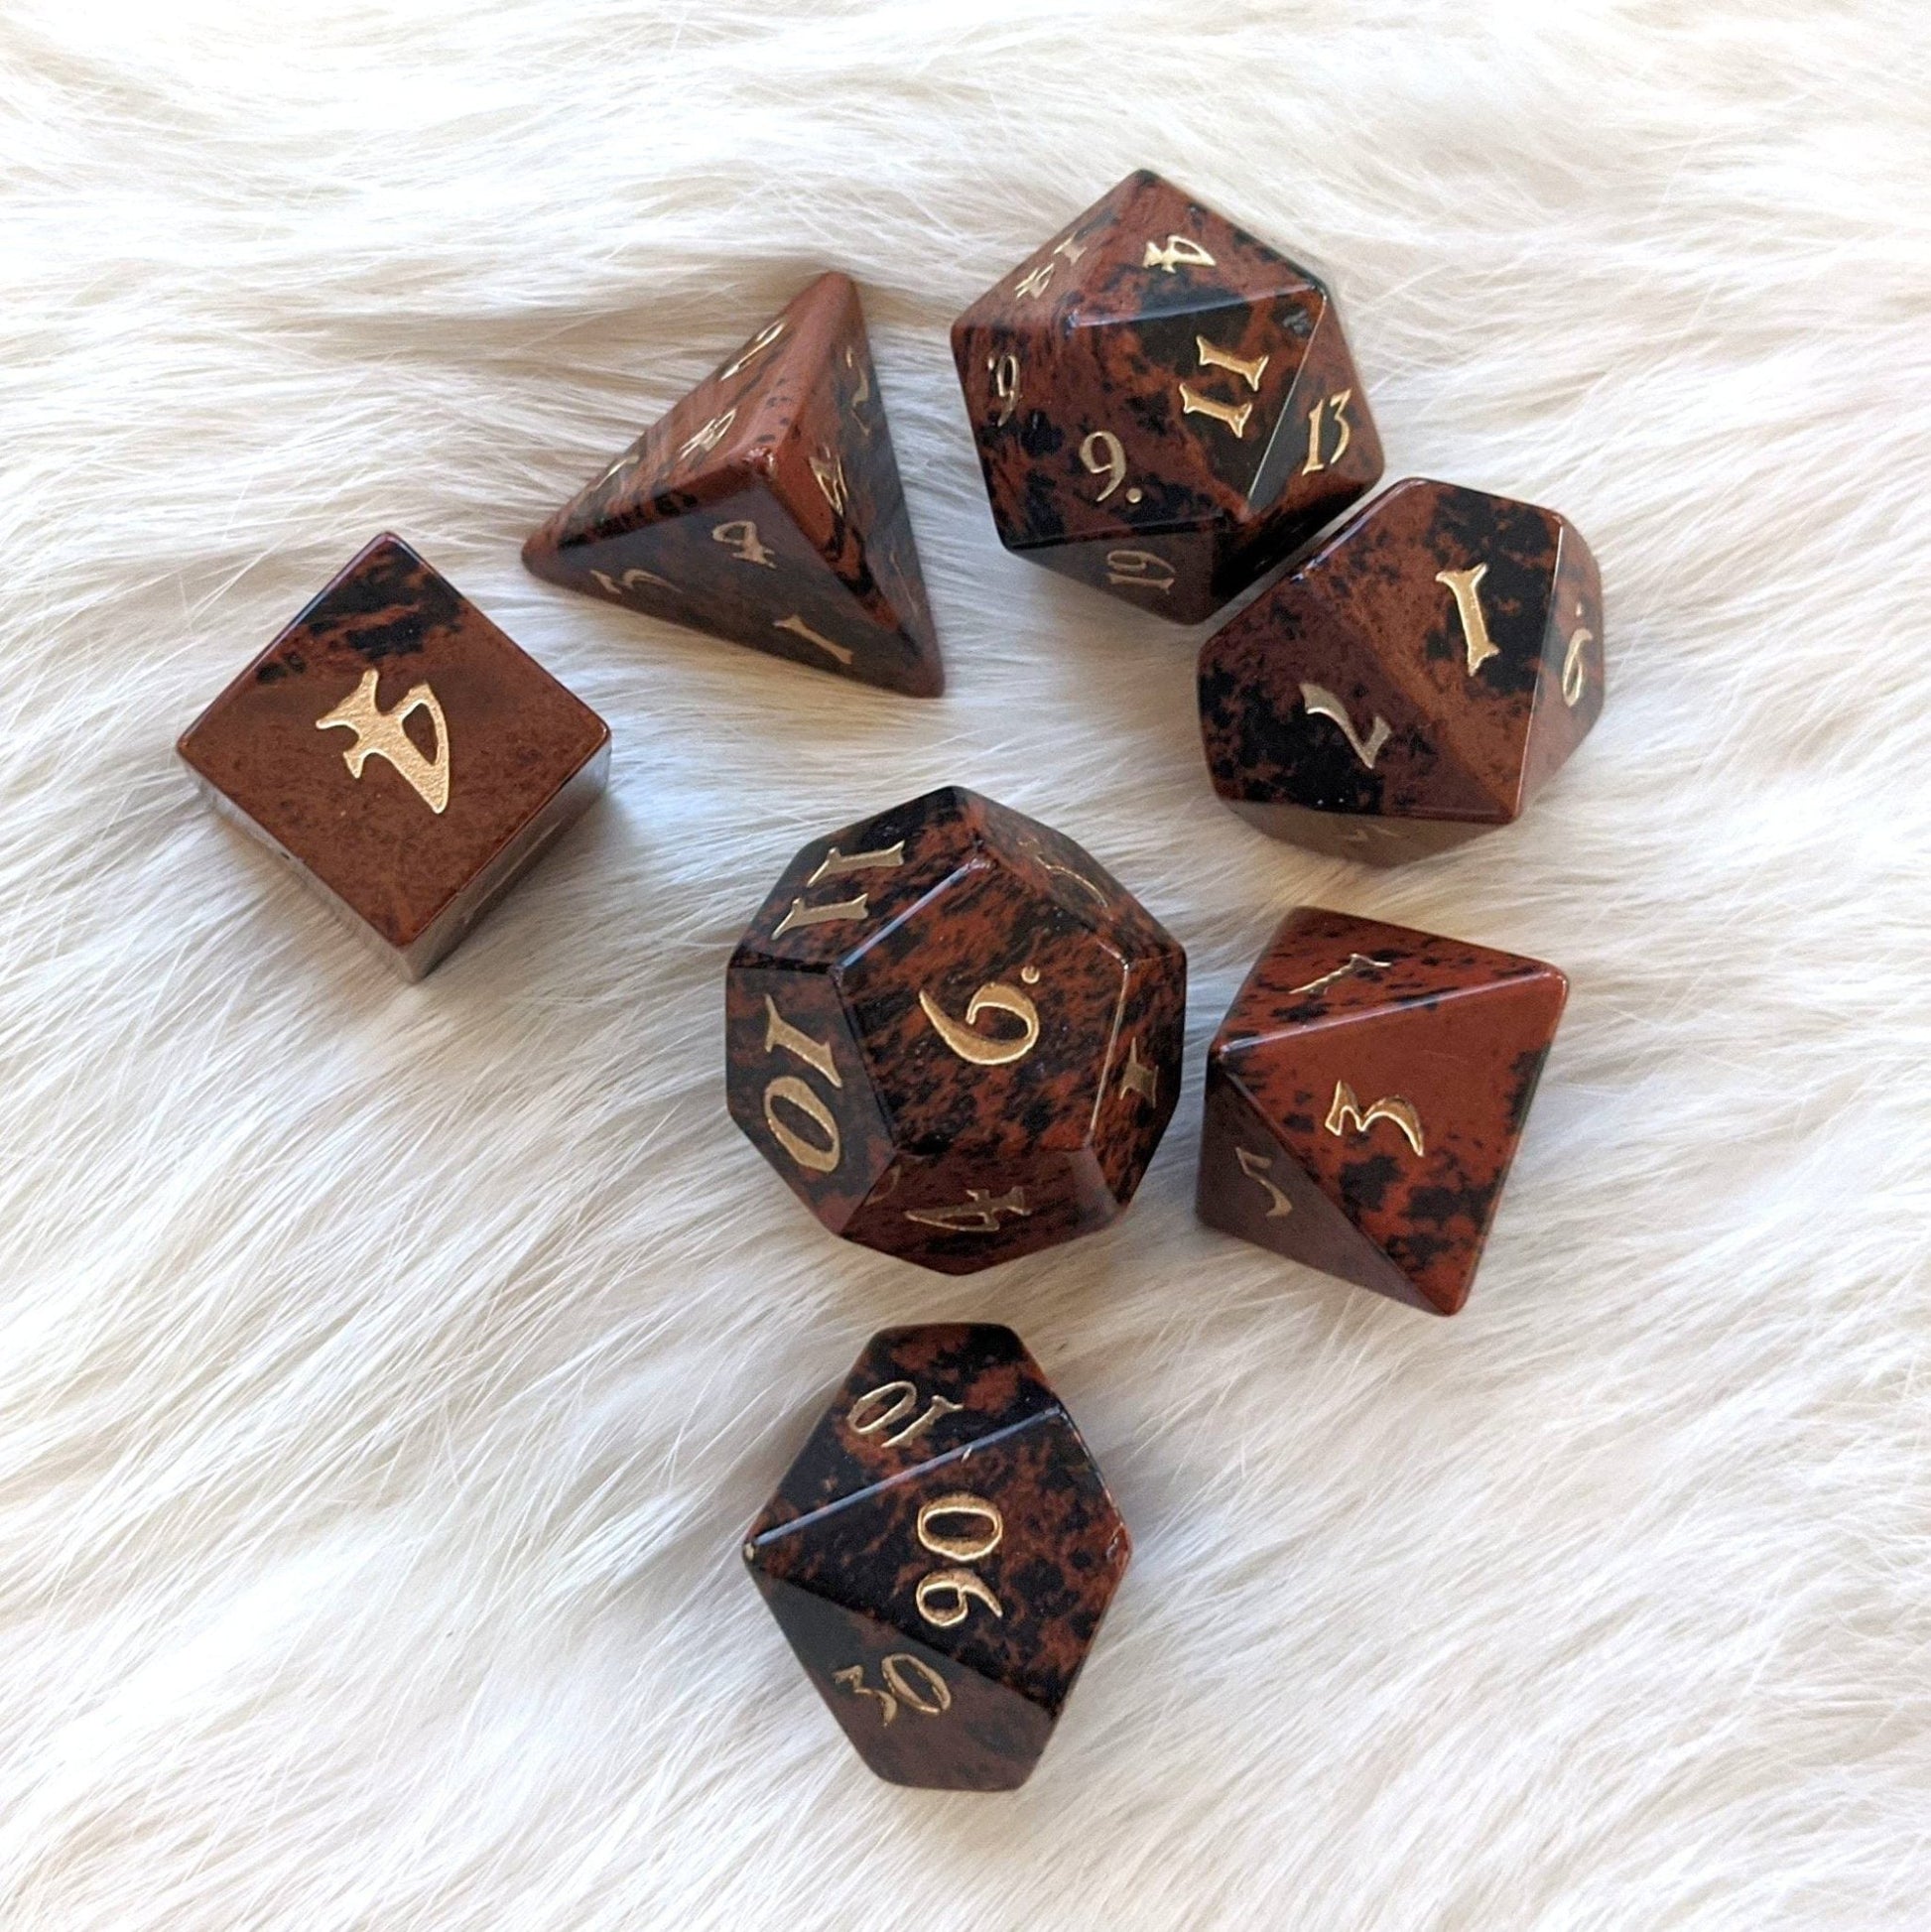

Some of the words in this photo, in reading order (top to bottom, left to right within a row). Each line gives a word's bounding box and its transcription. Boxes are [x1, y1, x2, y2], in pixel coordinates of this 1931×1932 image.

[1143, 234, 1217, 273] 4
[1179, 333, 1270, 439] 11
[1302, 387, 1352, 477] 13
[711, 520, 777, 570] 4
[773, 614, 855, 666] 1
[1435, 562, 1501, 678] 1
[315, 667, 451, 816] 4
[771, 839, 906, 942] 11
[763, 993, 843, 1174] 10
[1324, 1080, 1426, 1159] 3
[904, 1185, 1033, 1233] 4
[845, 1379, 966, 1450] 10
[915, 1493, 1005, 1628] 90
[832, 1652, 953, 1729] 30
